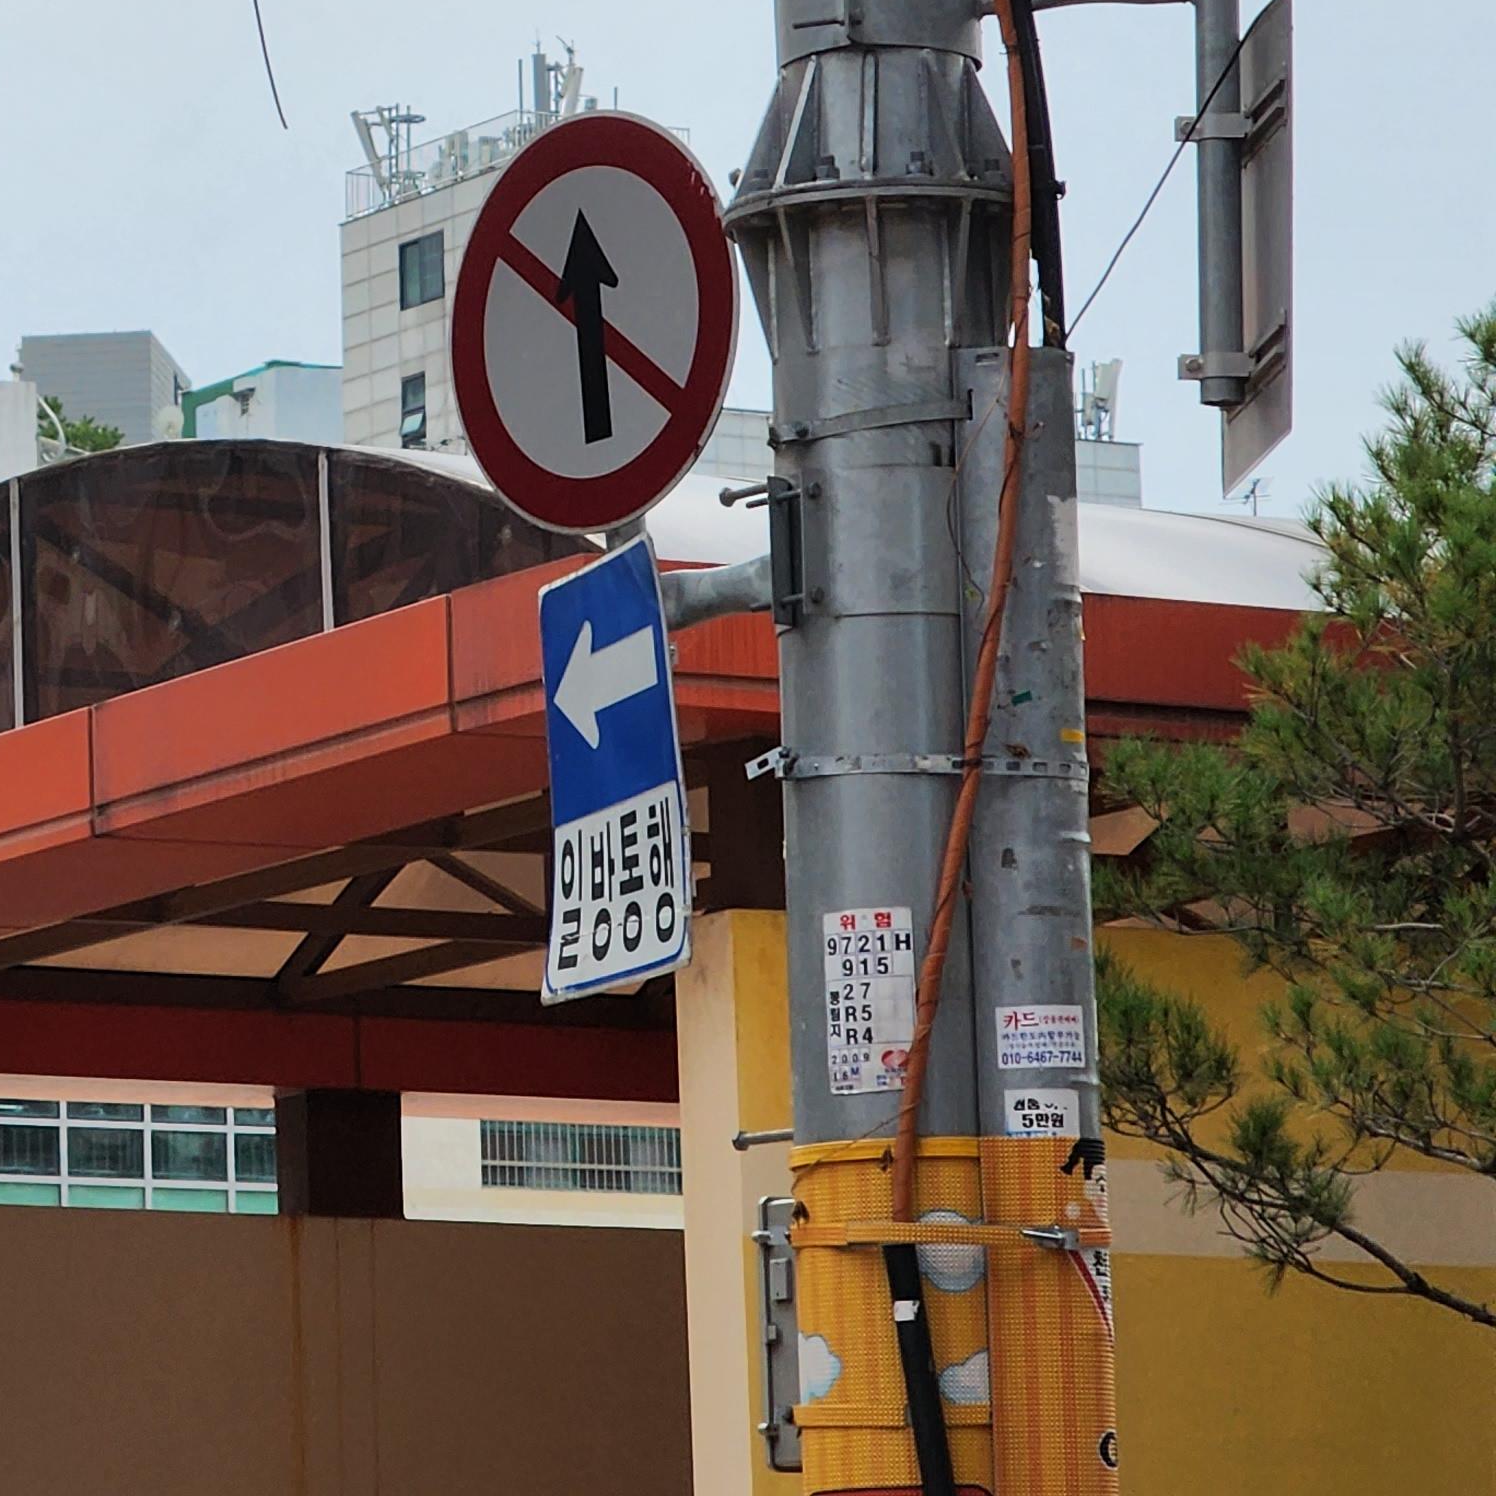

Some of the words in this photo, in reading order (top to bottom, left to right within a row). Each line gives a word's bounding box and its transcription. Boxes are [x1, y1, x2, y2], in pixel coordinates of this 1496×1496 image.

[557, 797, 675, 971] 일방통행
[827, 933, 911, 956] 9721H
[842, 957, 889, 977] 915
[1002, 1011, 1040, 1032] 카드
[1001, 1050, 1082, 1065] 010-6467-7744
[1022, 1112, 1065, 1129] 5만원
